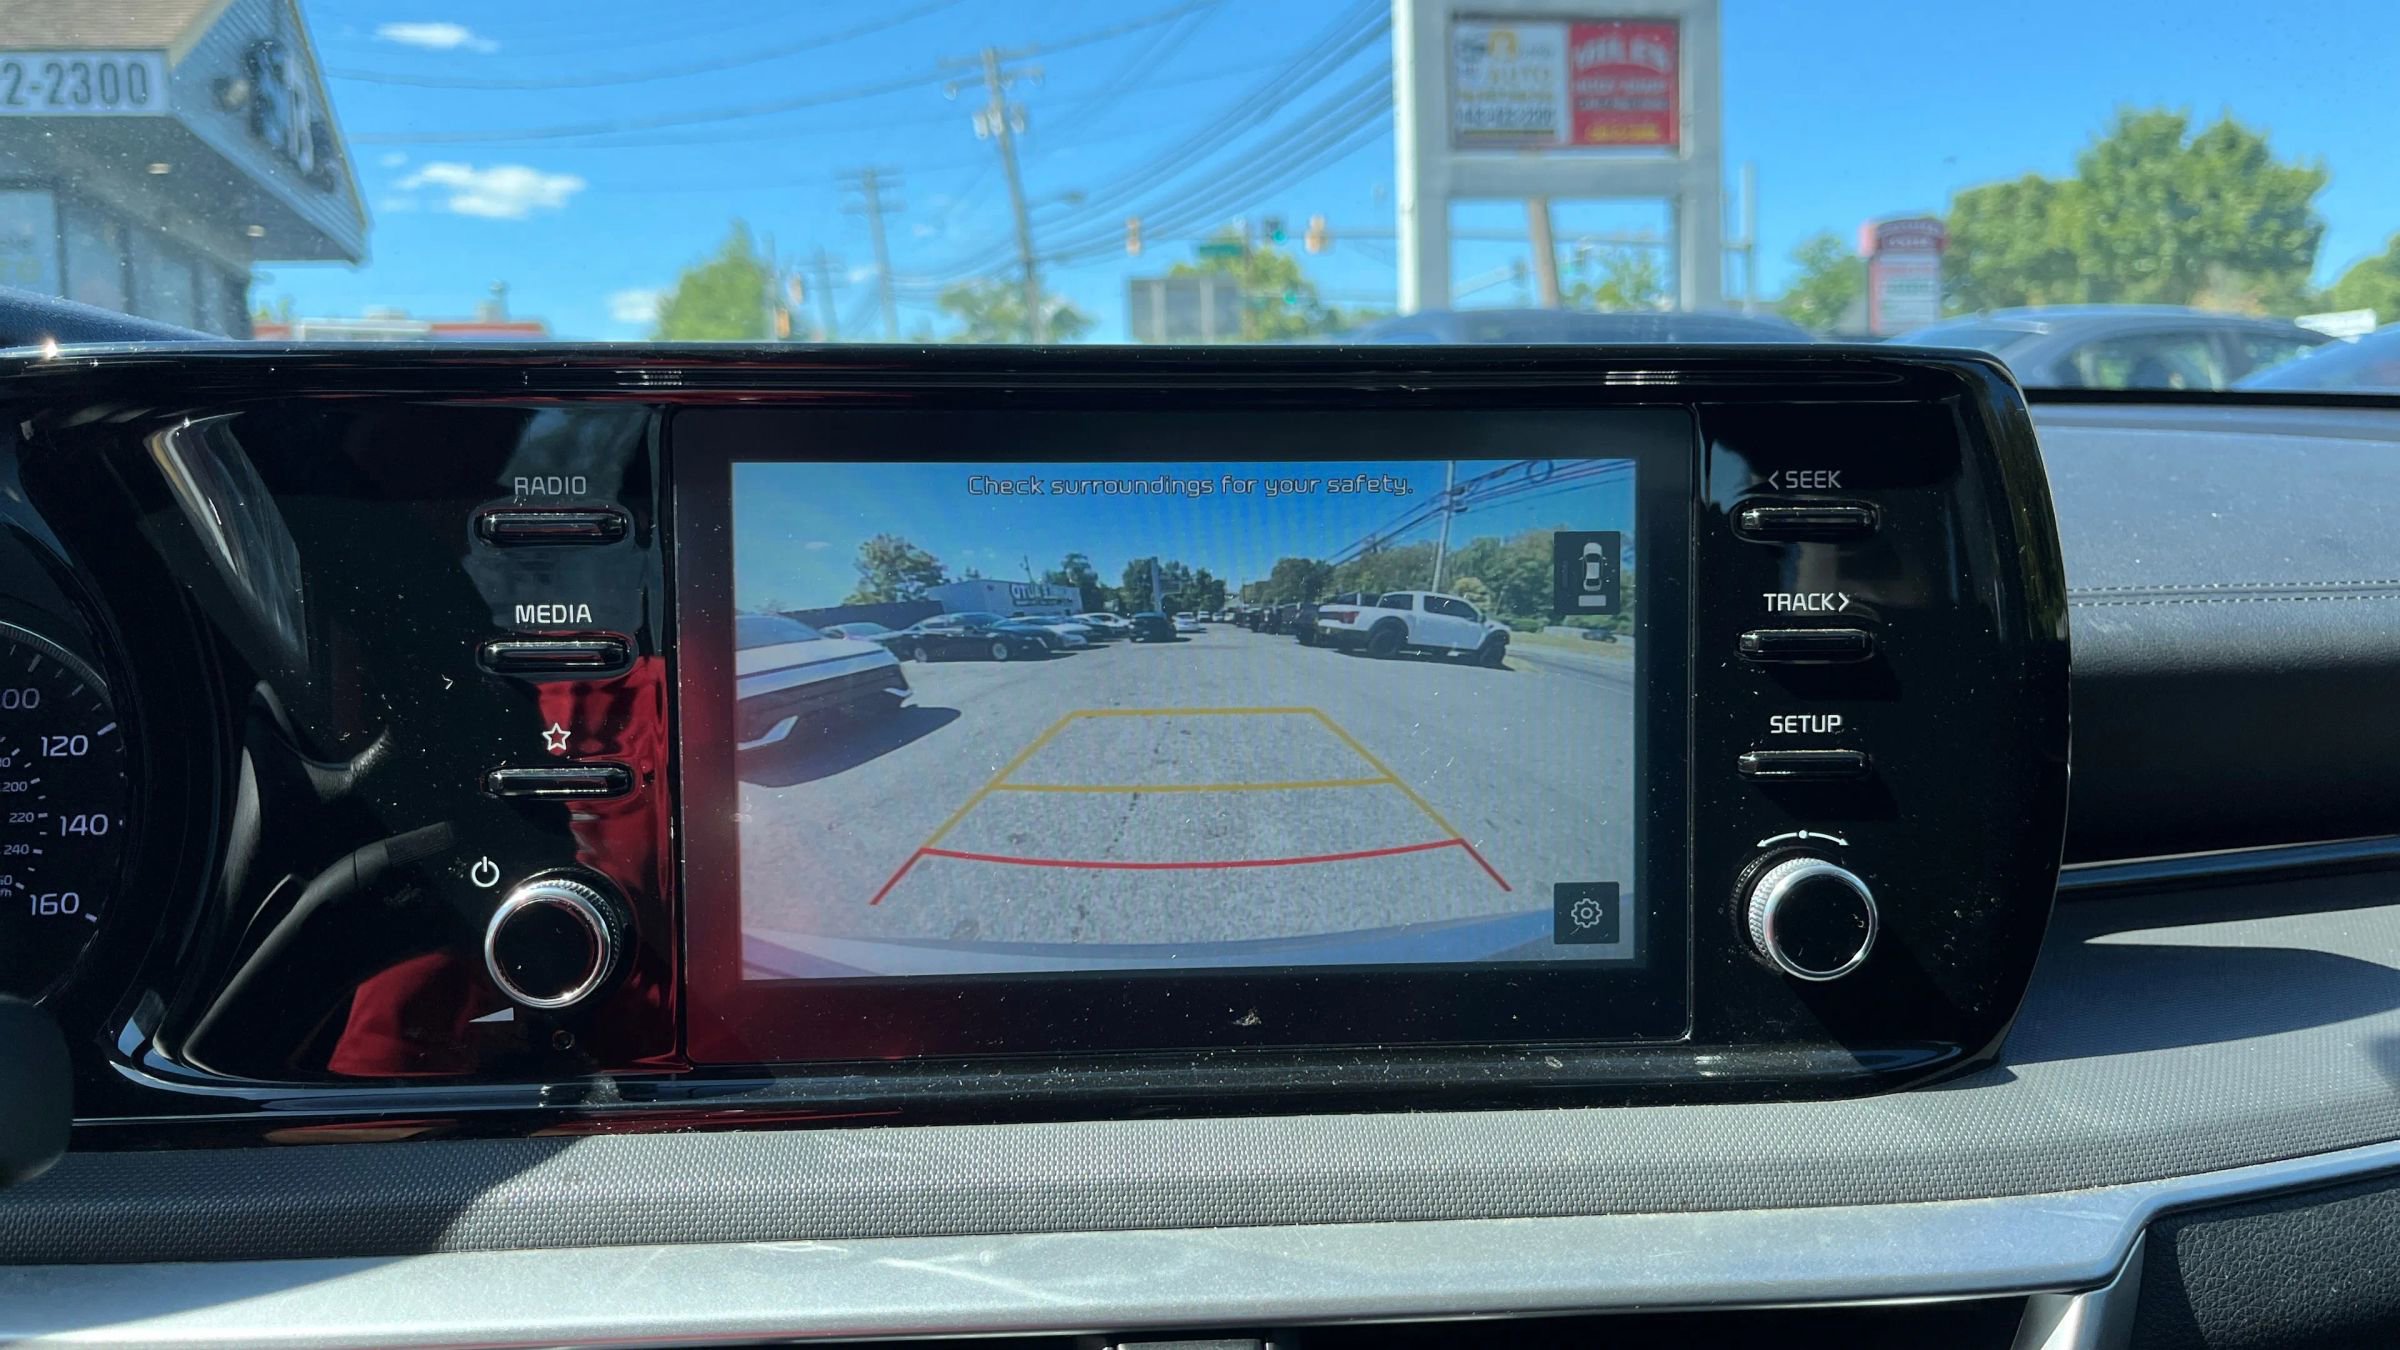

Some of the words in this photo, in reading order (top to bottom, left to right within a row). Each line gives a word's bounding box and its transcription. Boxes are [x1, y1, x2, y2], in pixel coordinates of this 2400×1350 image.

[3, 61, 148, 105] 2-2300
[514, 476, 587, 495] RADIO
[968, 475, 1045, 495] Check
[1050, 475, 1215, 498] surroundings
[1221, 475, 1258, 495] for
[1264, 477, 1321, 498] your
[1326, 474, 1414, 497] safety.
[1785, 470, 1841, 489] SEEK
[1763, 592, 1836, 612] TRACK
[515, 604, 593, 624] MEDIA
[1770, 714, 1842, 734] SETUP
[40, 734, 89, 757] 120
[2, 780, 28, 793] 200
[9, 812, 35, 823] 220
[59, 814, 108, 837] 140
[3, 844, 30, 855] 240
[30, 892, 80, 917] 160
